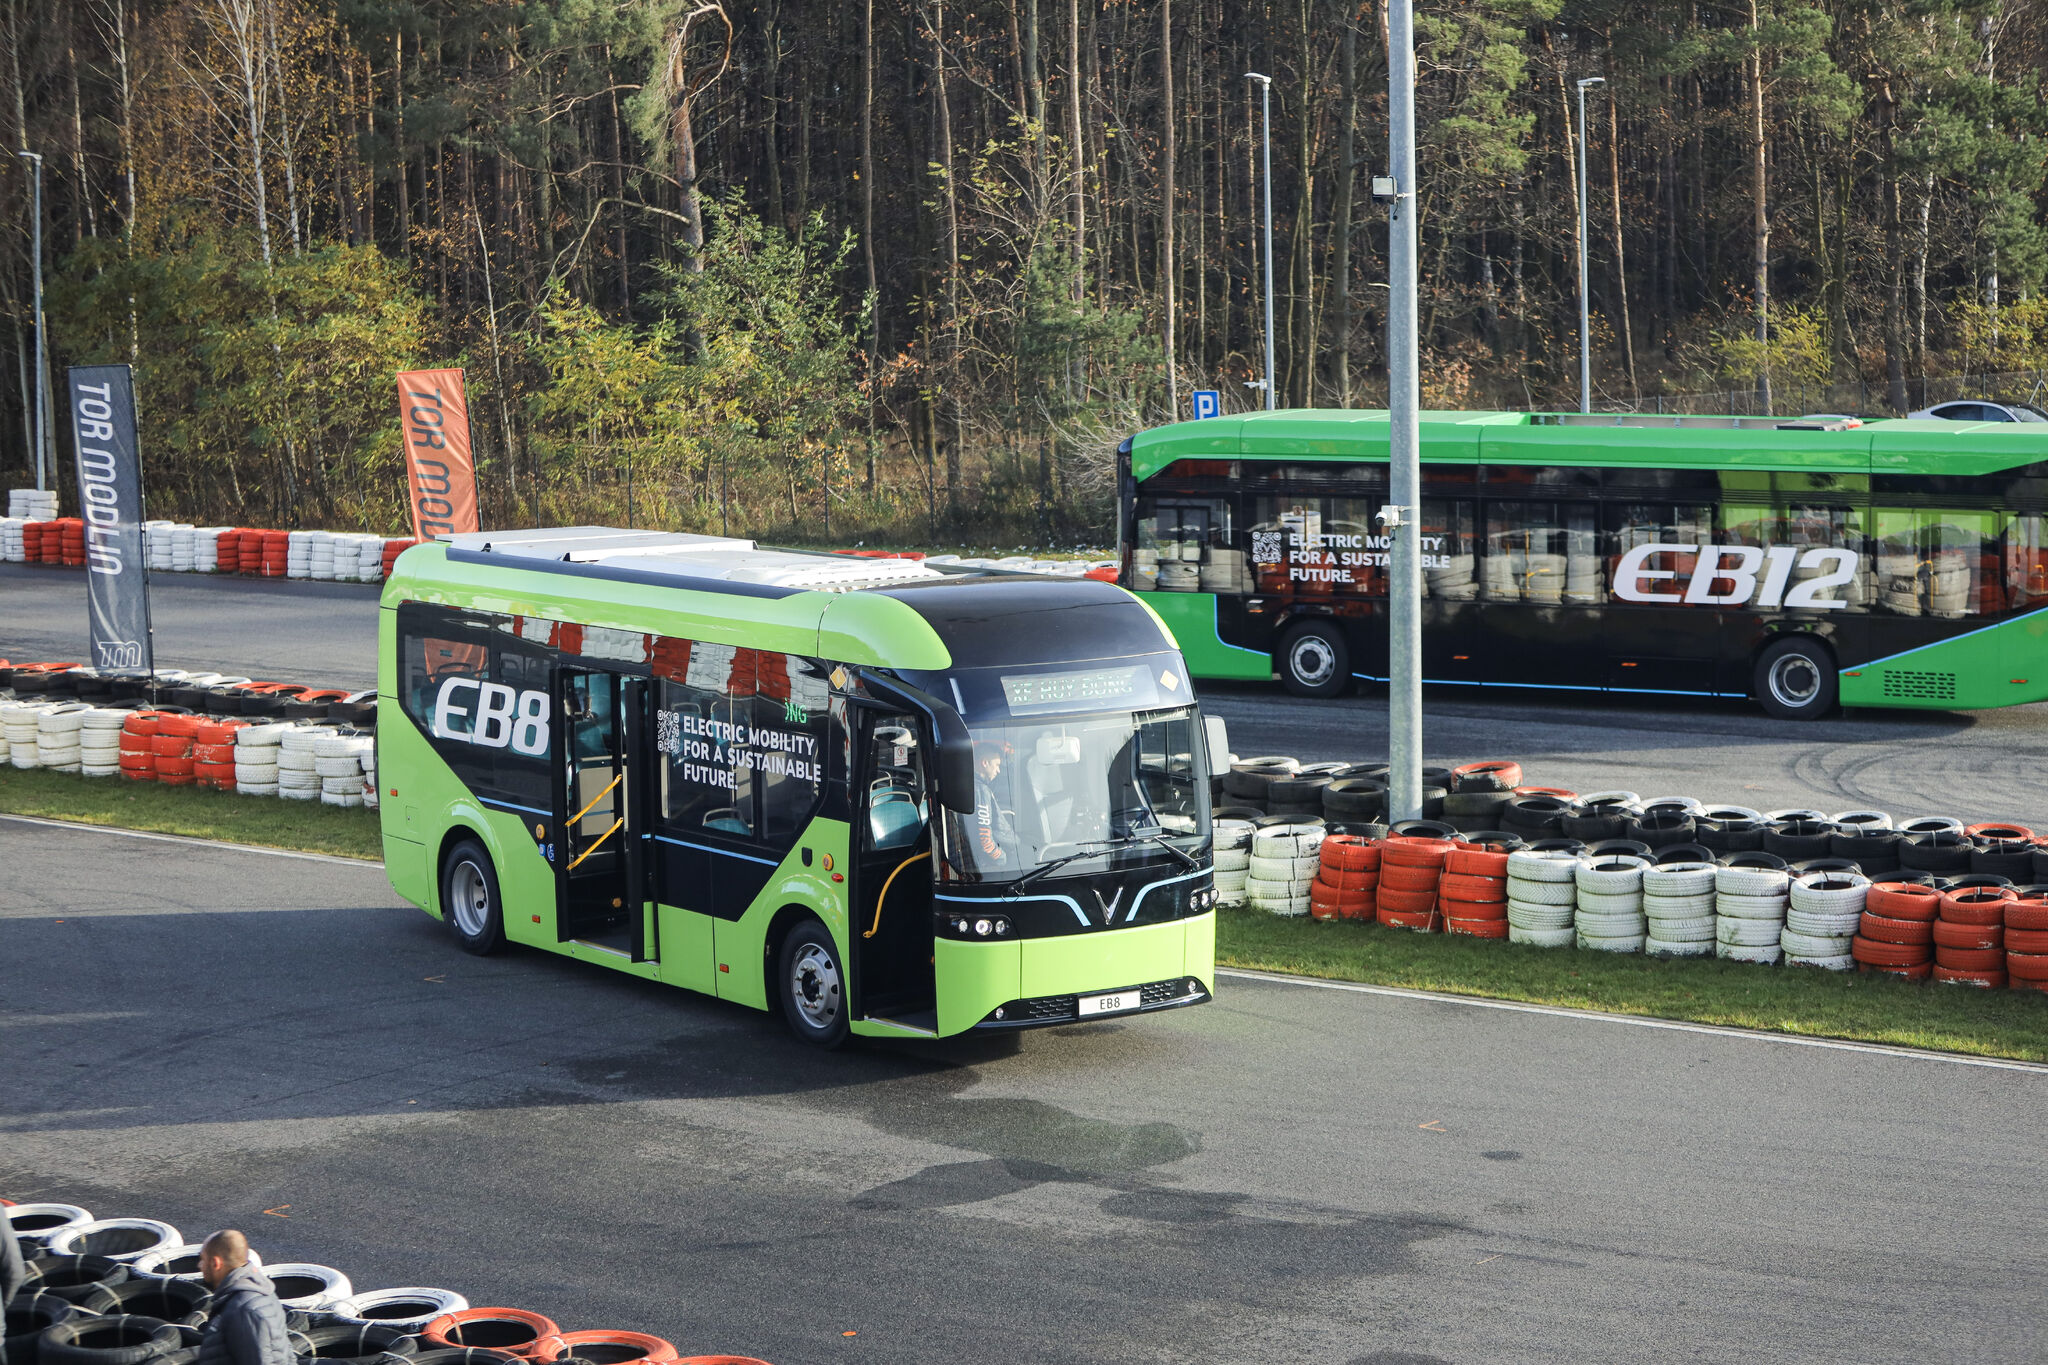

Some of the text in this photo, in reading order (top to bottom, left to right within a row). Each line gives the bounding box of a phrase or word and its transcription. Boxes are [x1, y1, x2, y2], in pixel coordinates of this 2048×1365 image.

[408, 388, 446, 450] TOR
[1198, 394, 1214, 420] P
[78, 382, 123, 576] TOR MODLIN
[1289, 533, 1443, 551] ELECTRIC MOTY
[1289, 551, 1451, 568] FOR A SUSTABLE
[1289, 567, 1356, 583] FUTURE.
[1612, 543, 1859, 609] EB12
[434, 676, 551, 756] EB8
[683, 716, 815, 756] ELECTRIC MOBILITY
[683, 739, 822, 783] FOR A SUSTAINABLE
[683, 762, 738, 791] FUTURE.
[978, 804, 991, 826] TOR
[1100, 996, 1120, 1010] EB8
